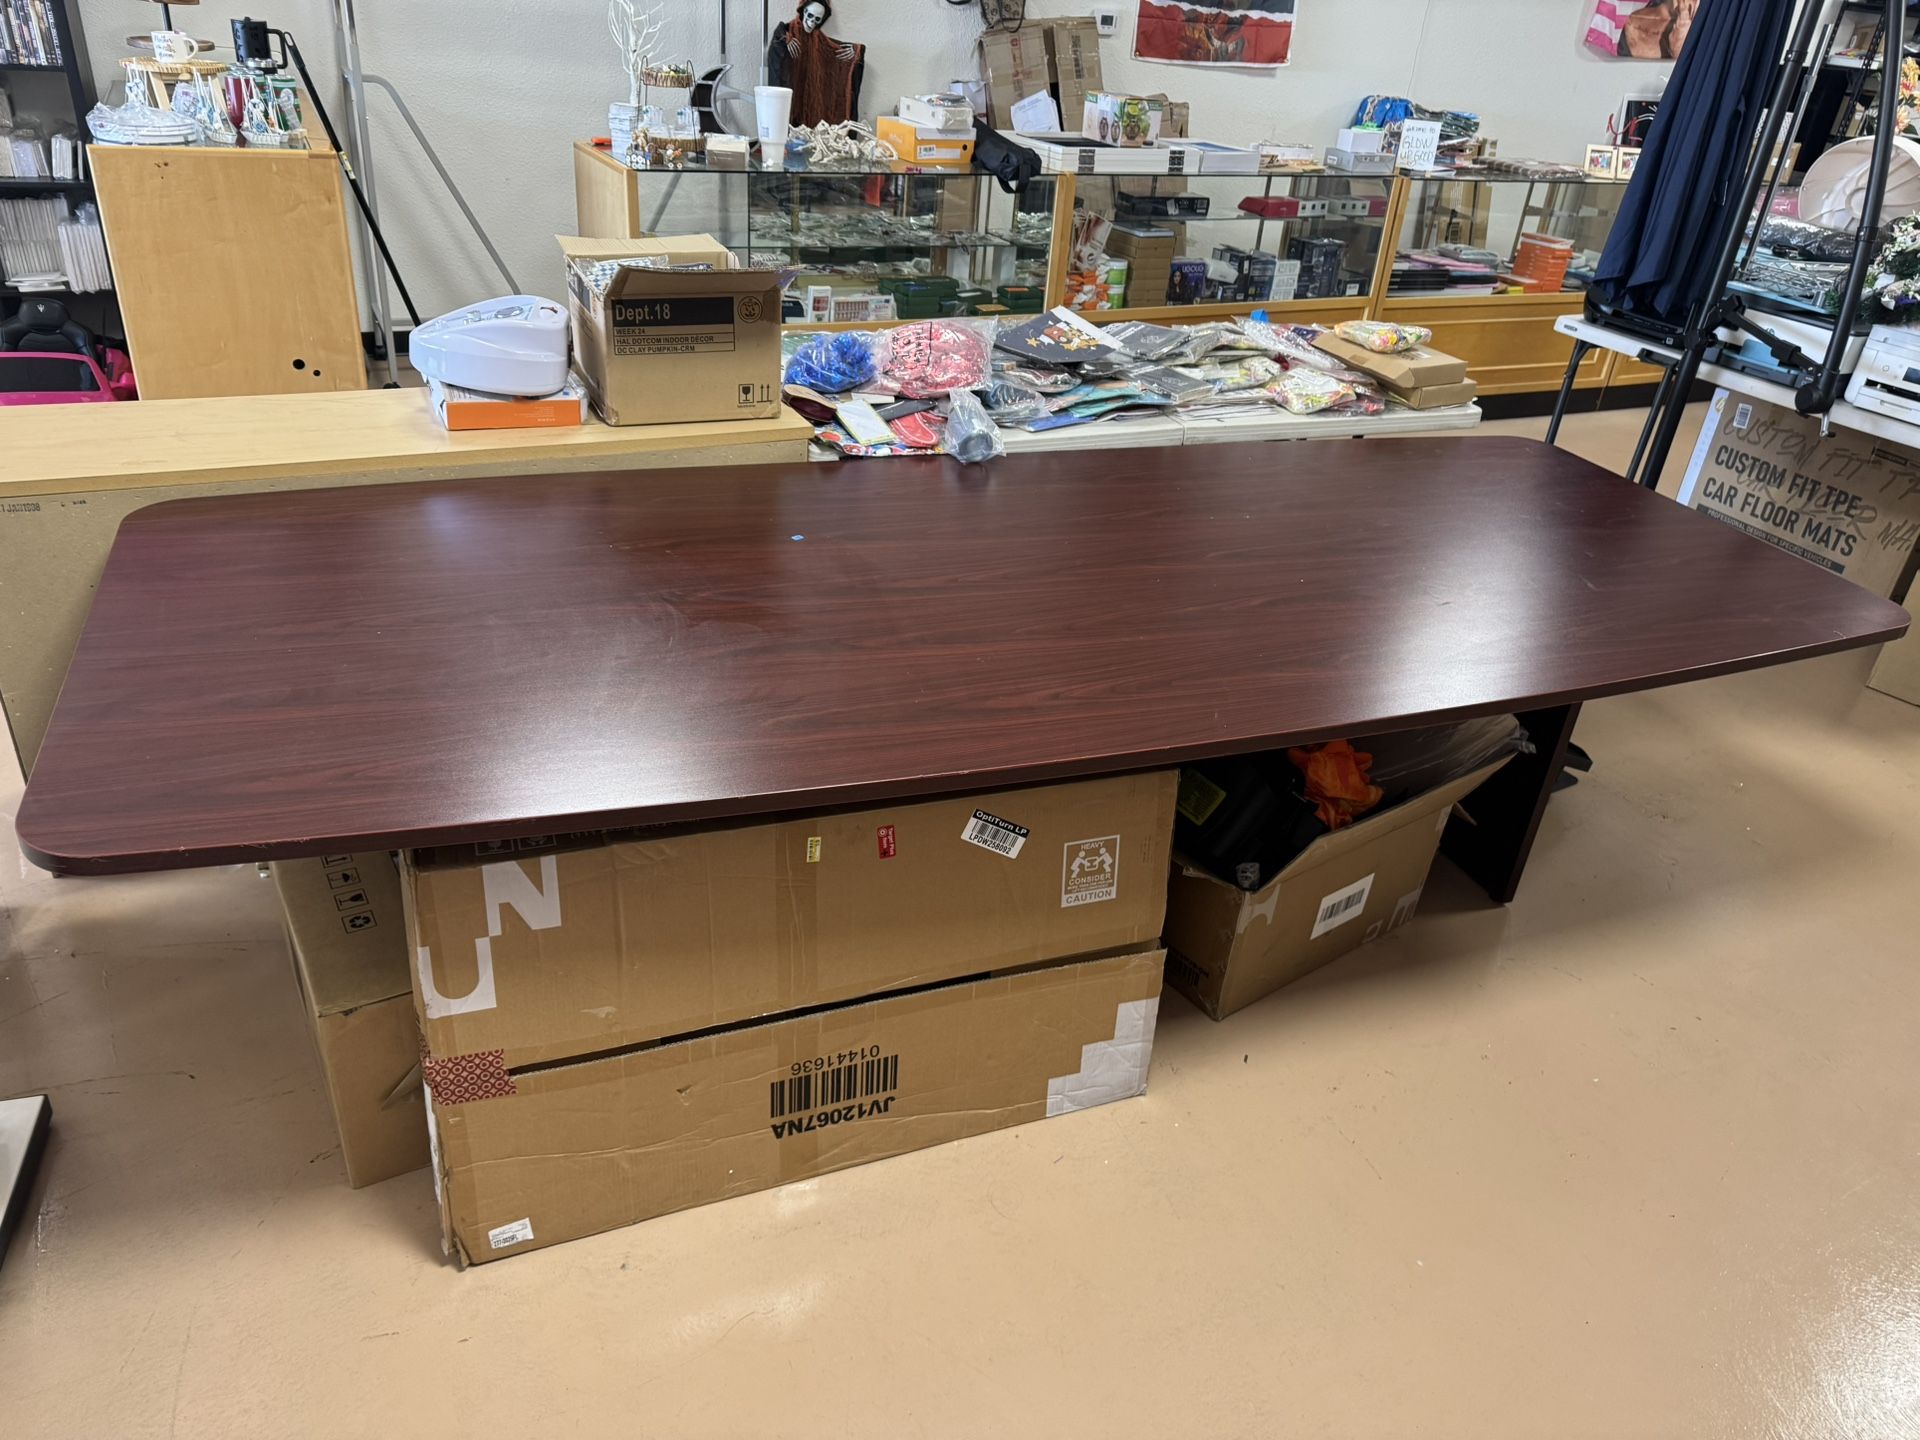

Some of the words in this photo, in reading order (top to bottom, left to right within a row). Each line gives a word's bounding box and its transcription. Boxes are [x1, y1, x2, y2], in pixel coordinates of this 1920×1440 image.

[615, 303, 671, 324] Dept.18
[616, 338, 631, 346] HAL
[632, 337, 662, 345] DOTCOM
[662, 336, 689, 344] INDOOR
[647, 345, 695, 353] PUMPKIN-CRM
[1715, 445, 1787, 490] CUSTOM
[1787, 472, 1821, 503] FIT
[1822, 485, 1862, 519] TPE
[1703, 477, 1738, 509] CAR
[1740, 492, 1800, 534] FLOOR
[1801, 517, 1858, 557] MATS
[1707, 508, 1745, 533] PROFESSIONAL
[1746, 525, 1767, 539] DESIGN
[1779, 539, 1803, 557] SPECIFIC
[1803, 549, 1832, 568] VEHICLES
[976, 810, 1014, 831] OptiTurn
[1015, 827, 1028, 835] LP
[1080, 841, 1105, 850] HEAVY
[1068, 873, 1112, 886] CONSIDER
[1065, 889, 1112, 904] CAUTION
[791, 1045, 880, 1076] 01441636
[770, 1096, 896, 1139] JV12067NA
